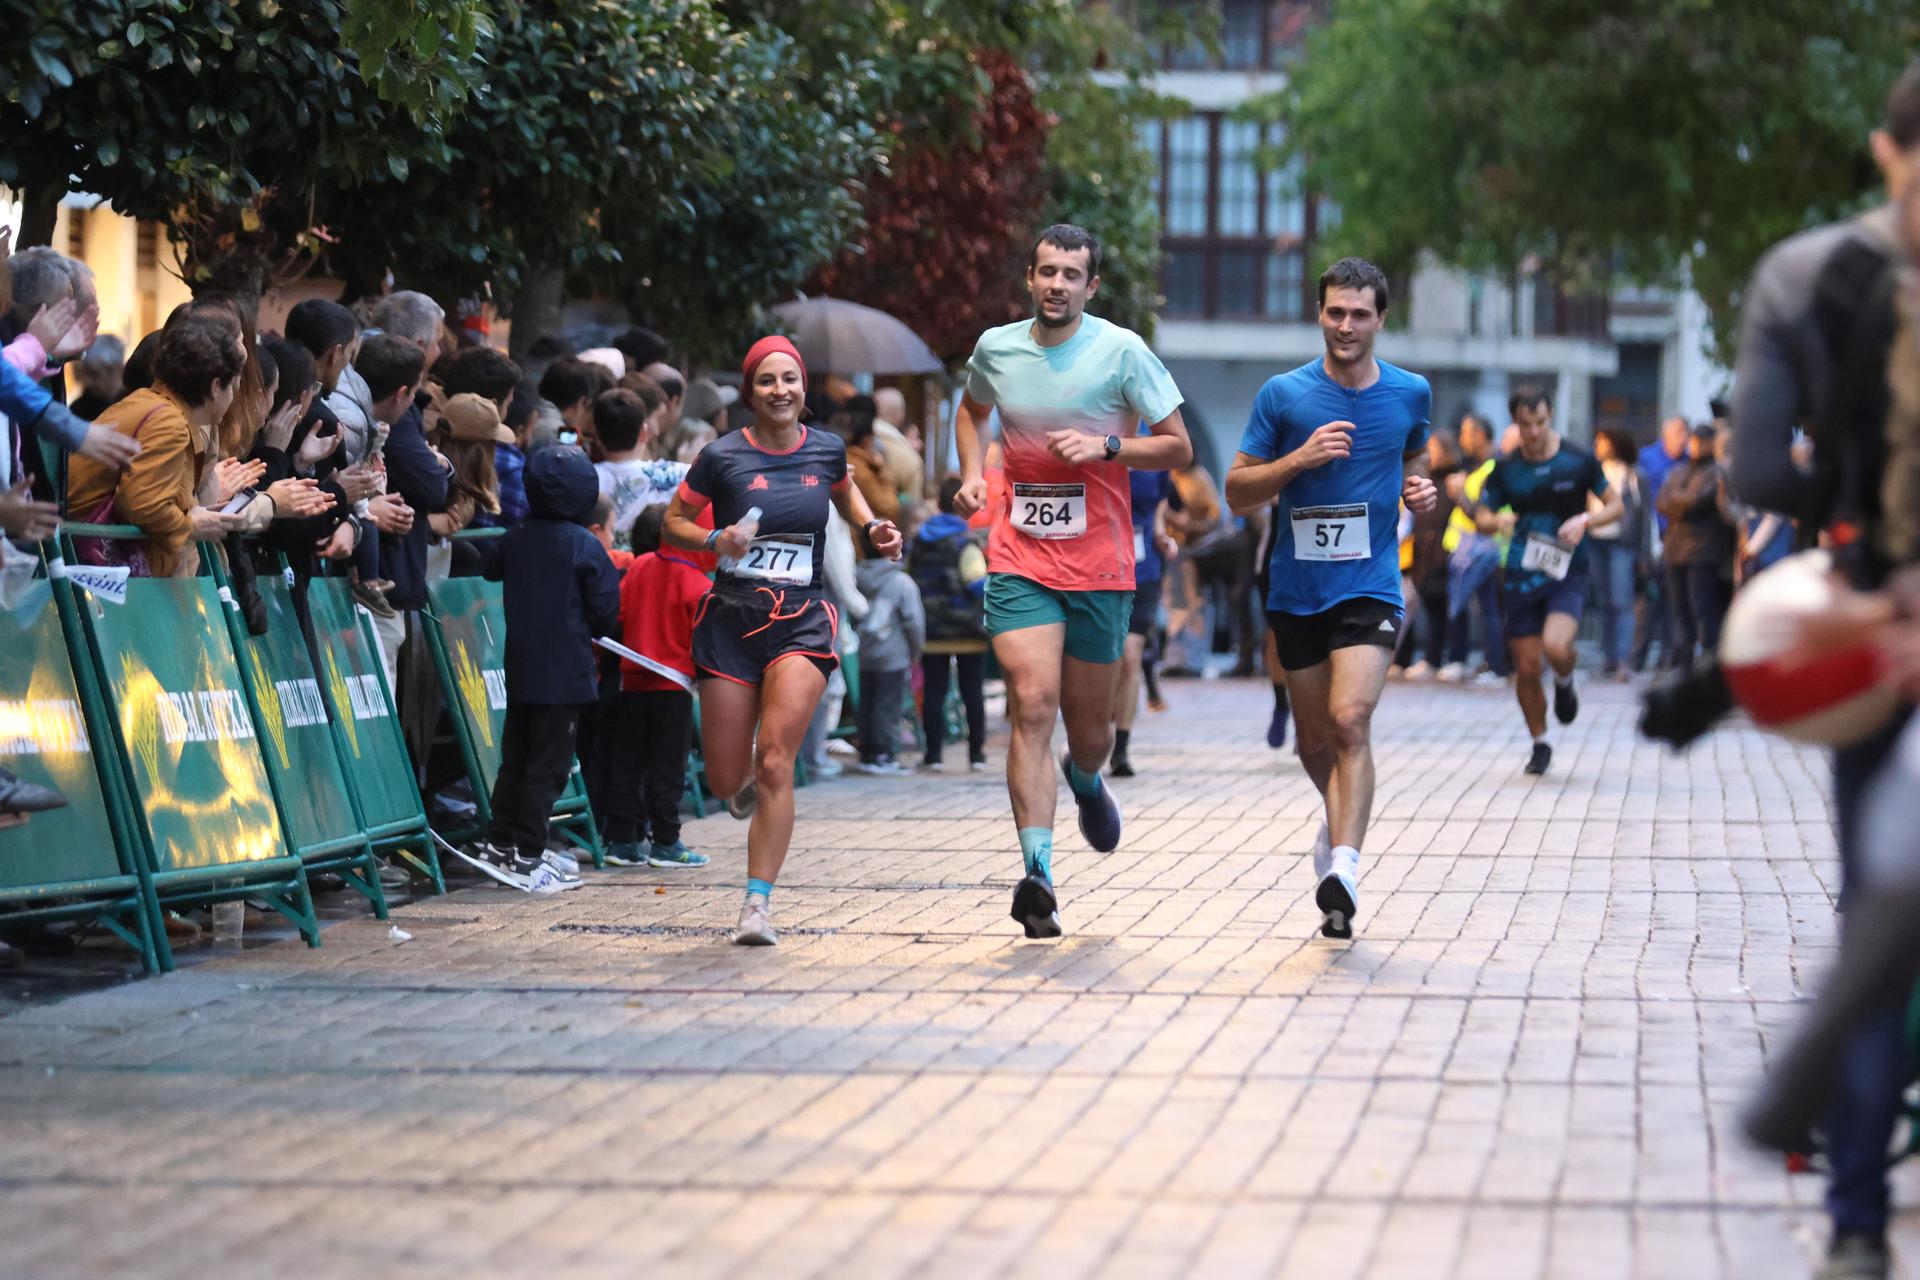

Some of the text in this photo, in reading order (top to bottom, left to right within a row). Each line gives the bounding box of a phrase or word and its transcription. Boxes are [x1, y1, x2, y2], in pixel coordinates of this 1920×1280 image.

[1023, 502, 1072, 526] 264
[1315, 523, 1346, 547] 57
[748, 546, 798, 571] 277
